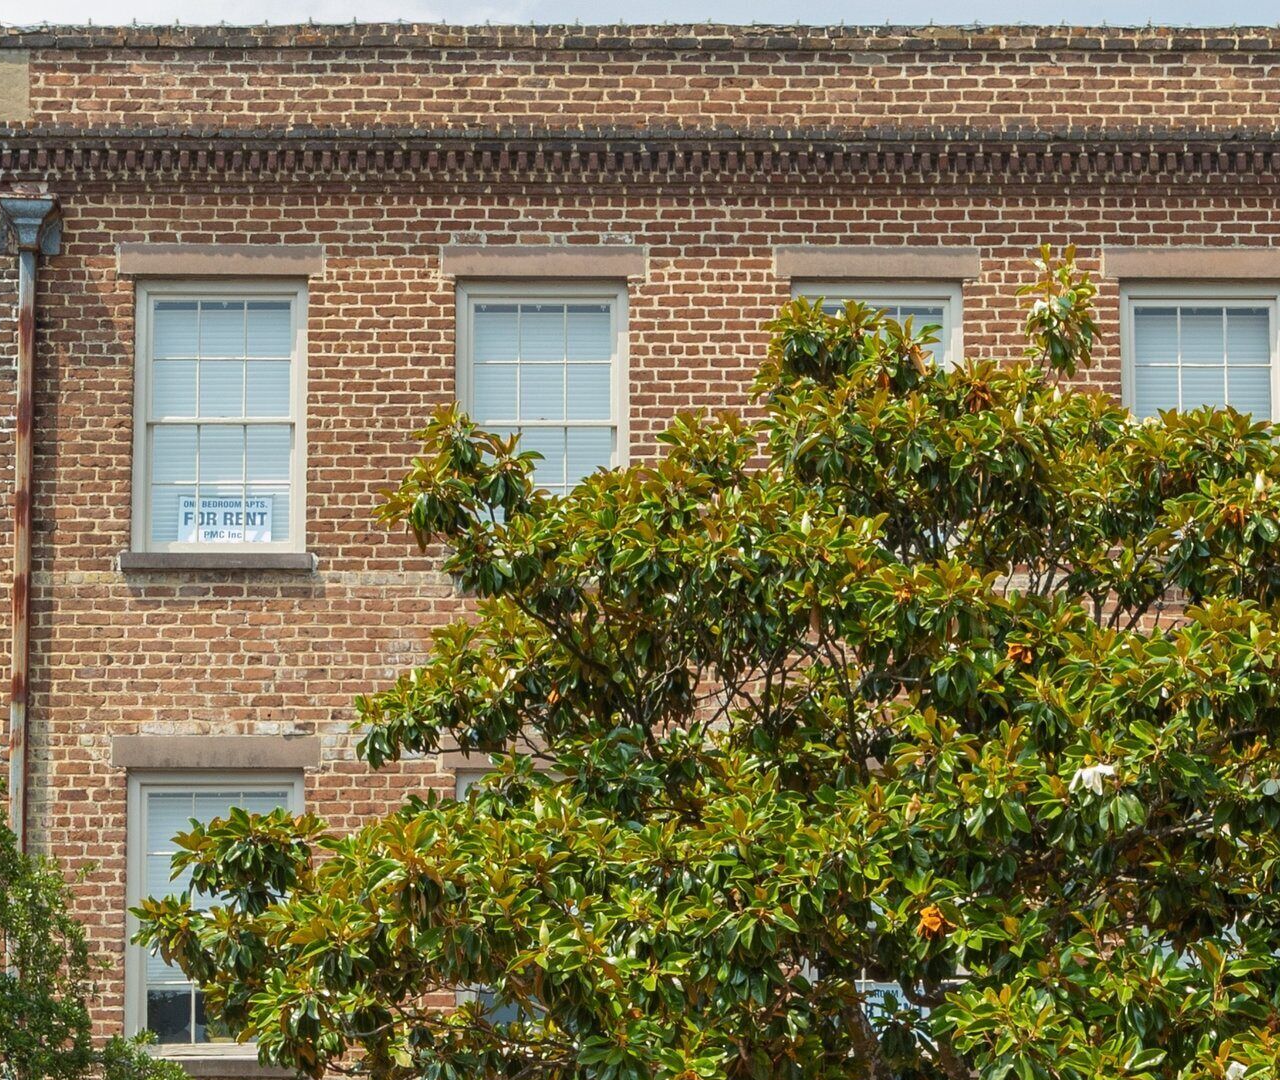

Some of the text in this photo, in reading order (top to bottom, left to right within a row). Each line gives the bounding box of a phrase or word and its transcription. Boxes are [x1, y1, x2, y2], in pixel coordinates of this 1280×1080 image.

[183, 500, 198, 509] ON
[202, 500, 242, 509] BEDROOM
[184, 511, 267, 526] FOR RENT
[203, 530, 225, 539] PMC
